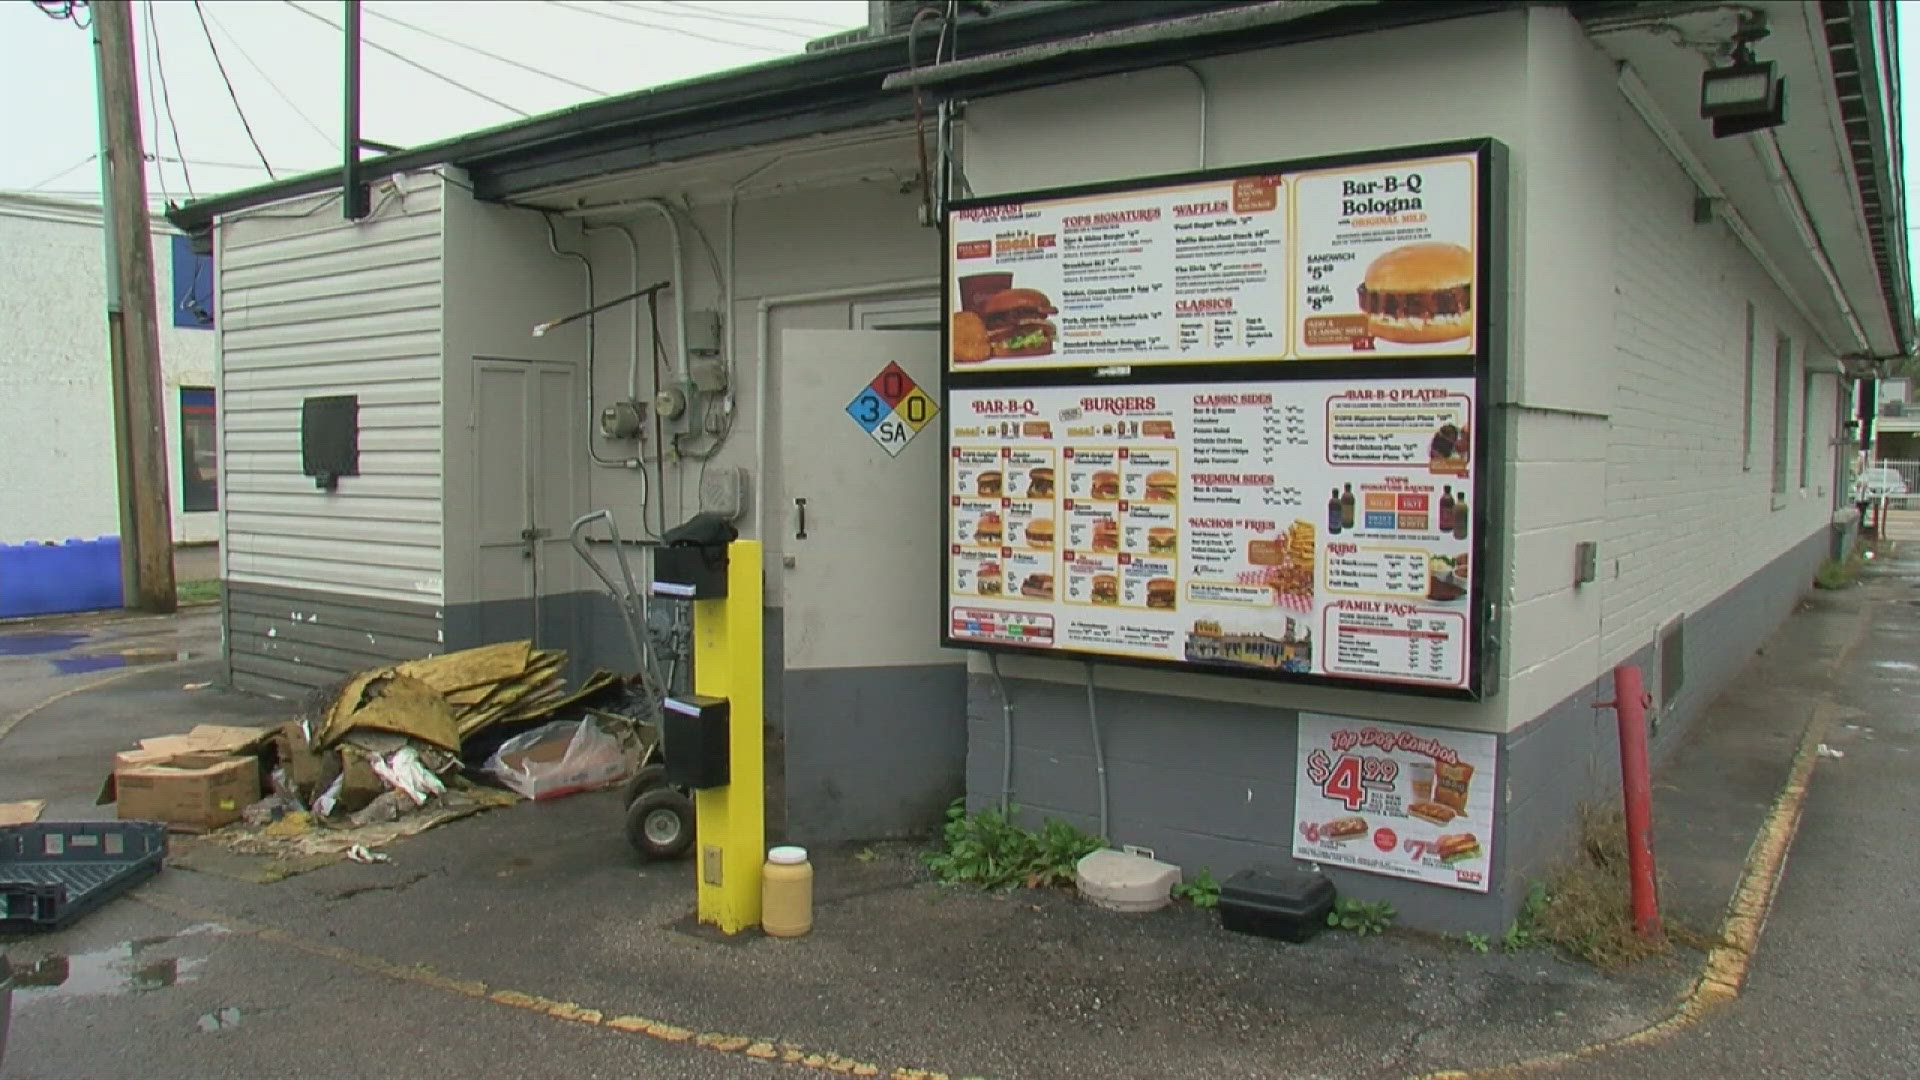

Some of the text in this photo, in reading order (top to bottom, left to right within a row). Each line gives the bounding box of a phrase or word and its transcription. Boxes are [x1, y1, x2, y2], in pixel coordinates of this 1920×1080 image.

[1343, 174, 1422, 196] Bar-B-Q
[1173, 200, 1228, 217] WAFFLES
[1343, 197, 1422, 216] Bologna
[1063, 207, 1161, 228] TOPS SIGNATURES
[1402, 212, 1427, 223] MILD
[1307, 252, 1355, 264] SANDWICH
[1307, 284, 1330, 294] MEAL
[1176, 298, 1233, 312] CLASSICS
[884, 372, 902, 398] 0
[1193, 393, 1272, 405] CLASSIC SIDES
[1345, 389, 1447, 402] BAR-B-Q PLATES
[861, 396, 926, 422] 3 0
[972, 399, 1039, 416] BAR-B-Q
[1080, 396, 1156, 415] BURGERS
[880, 421, 906, 442] SA
[1191, 474, 1274, 486] PREMIUM SIDES
[1189, 518, 1233, 528] NACHOS
[1245, 519, 1275, 533] FRIES
[1338, 600, 1417, 616] FAMILY PACK
[1331, 726, 1460, 765] Top Dog Combos
